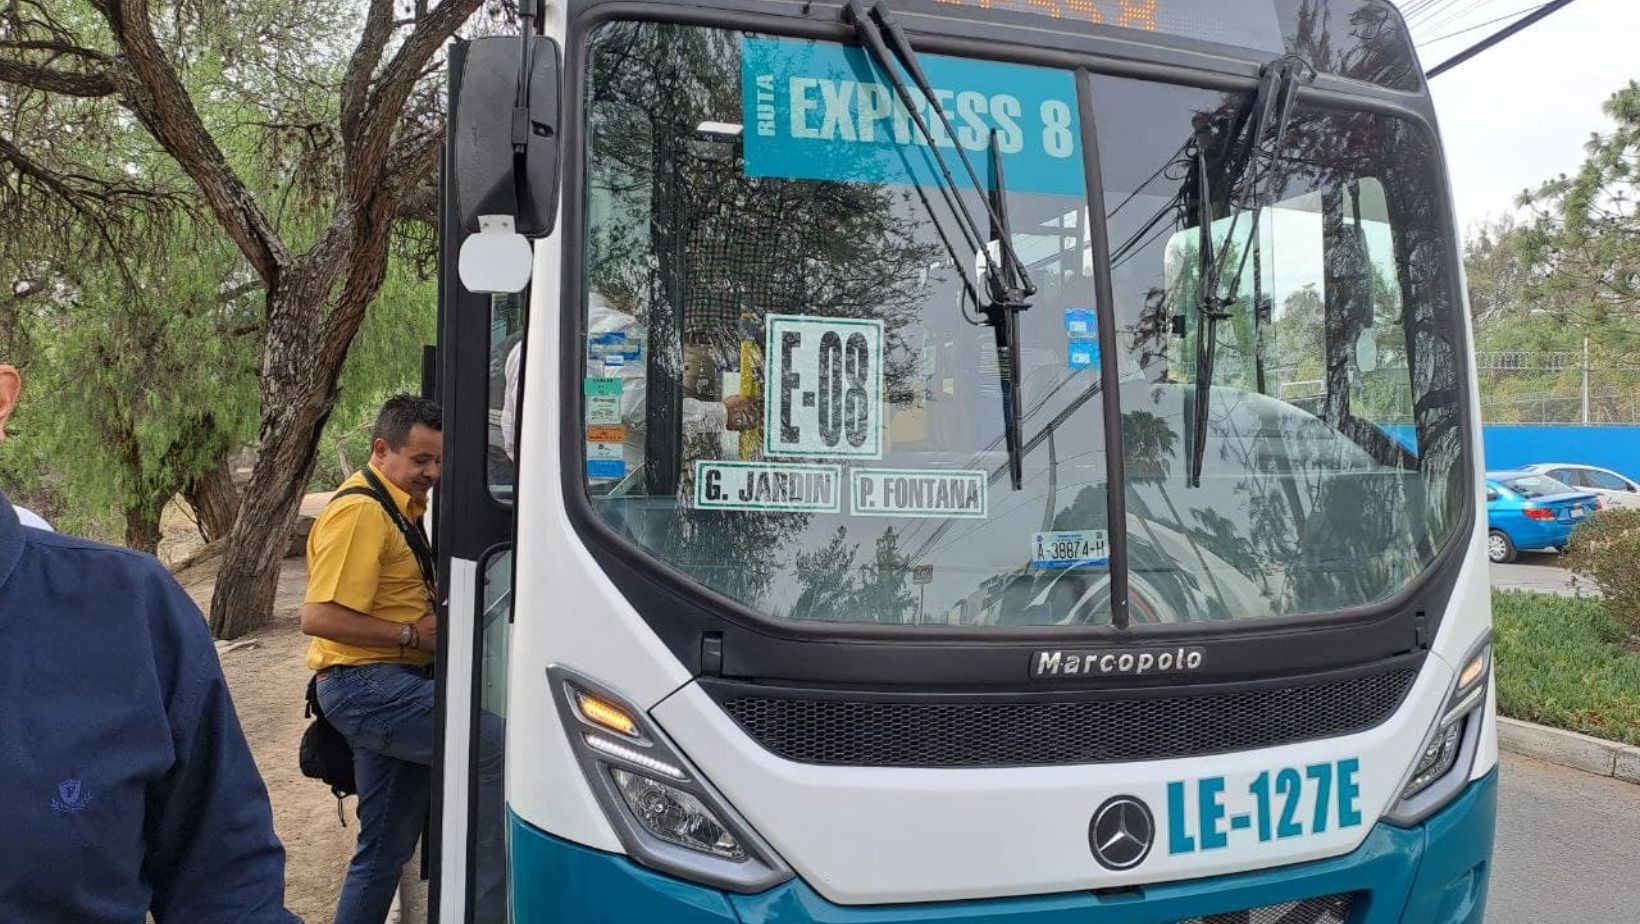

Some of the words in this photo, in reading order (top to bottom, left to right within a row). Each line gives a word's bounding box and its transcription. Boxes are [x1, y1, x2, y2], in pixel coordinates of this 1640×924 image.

[756, 74, 776, 136] RUTA
[789, 76, 1025, 154] EXPRESS
[1040, 99, 1075, 158] 8
[780, 330, 869, 448] E-08
[705, 469, 729, 501] G.
[738, 470, 831, 504] JARDIN
[860, 476, 875, 507] P.
[883, 477, 980, 509] FONTANA
[1036, 648, 1203, 675] Marcopolo
[1166, 757, 1363, 856] LE-127E
